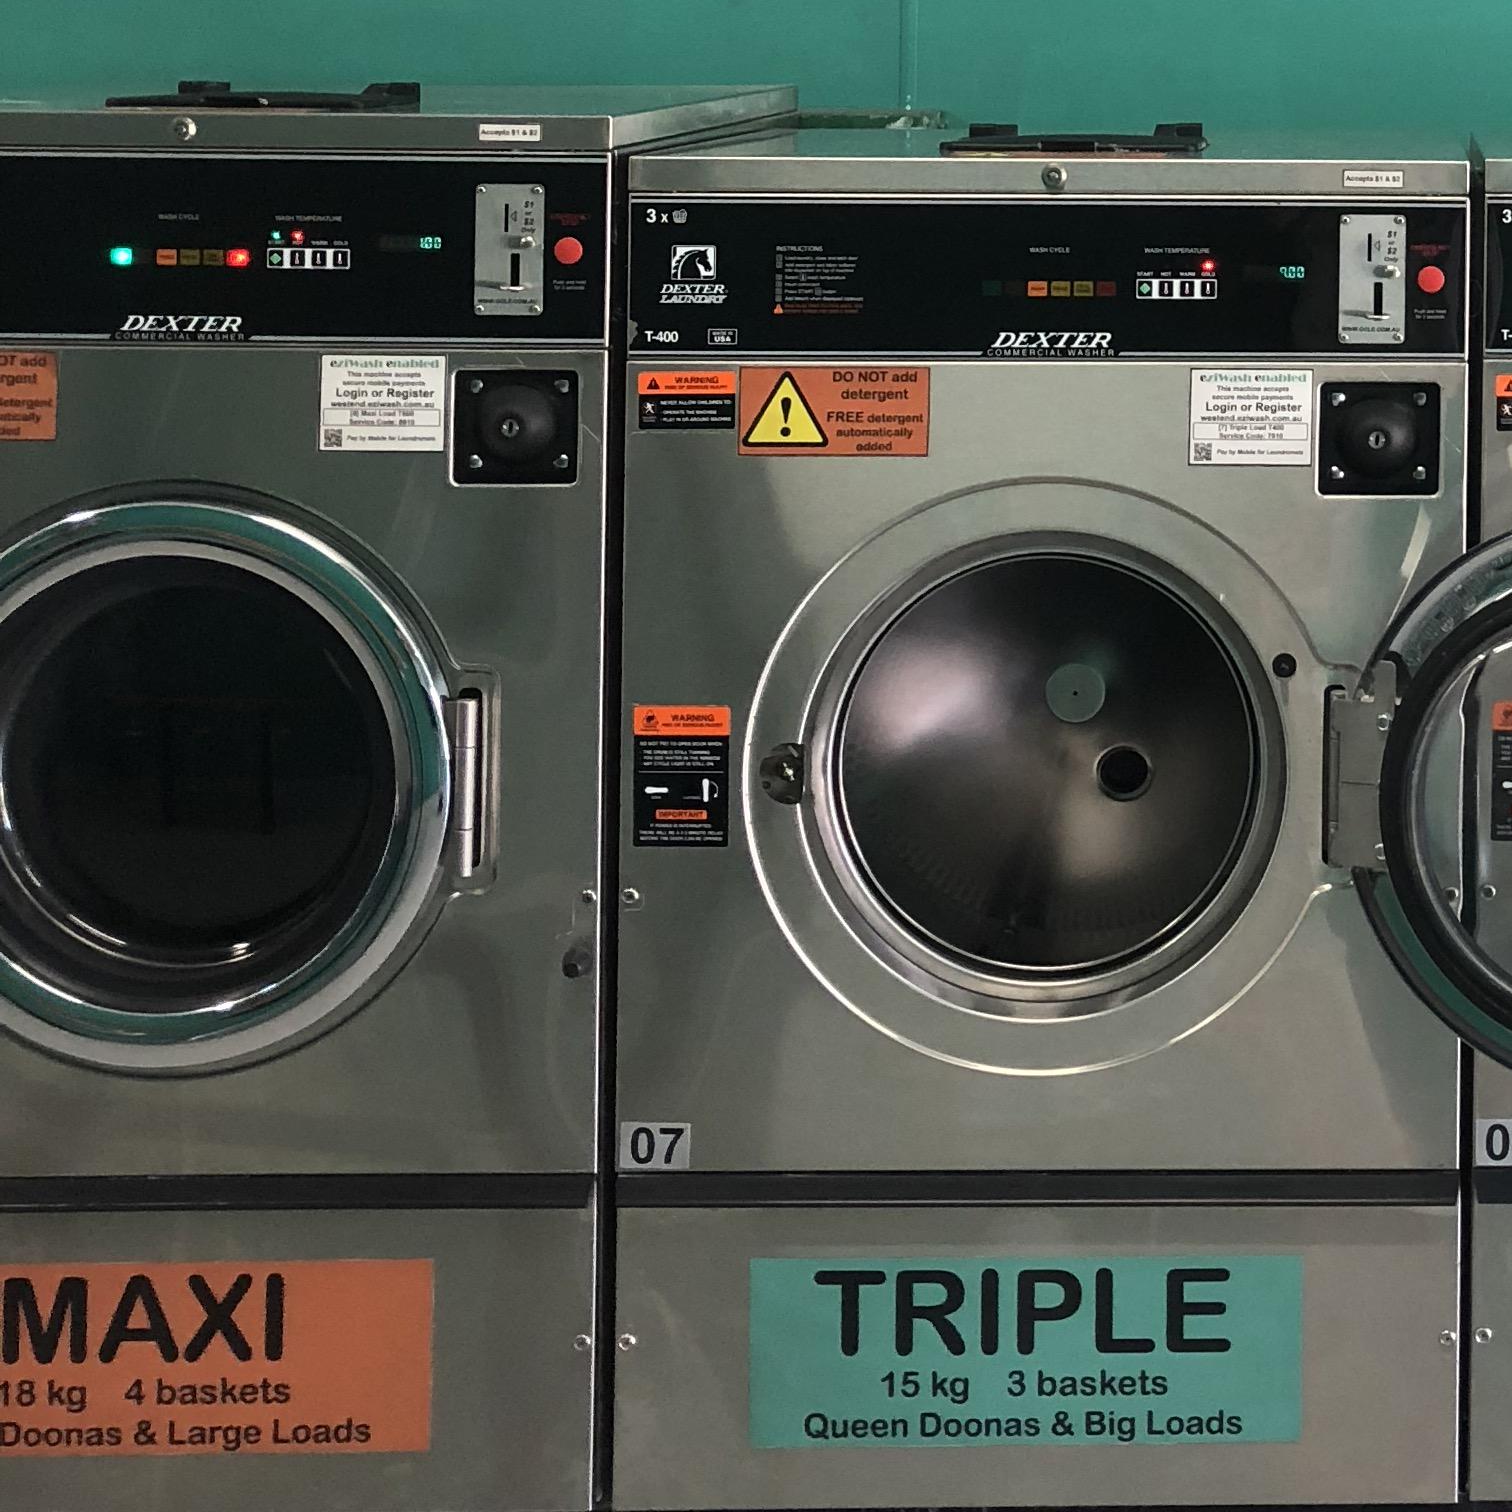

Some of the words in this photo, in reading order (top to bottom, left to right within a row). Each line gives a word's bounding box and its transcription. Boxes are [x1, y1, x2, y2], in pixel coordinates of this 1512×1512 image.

[646, 210, 656, 223] 3
[661, 213, 668, 223] x
[660, 284, 725, 294] DEXTER
[659, 295, 726, 304] LAUNDRY
[120, 316, 242, 332] DEXTER
[646, 331, 679, 342] T-400
[991, 332, 1112, 348] DEXTER
[833, 371, 854, 383] DO
[858, 371, 888, 383] NOT
[892, 371, 917, 383] add
[336, 388, 367, 400] Login
[387, 389, 435, 400] Register
[841, 387, 909, 402] detergent
[1206, 402, 1237, 413] Login
[1256, 402, 1302, 413] Register
[827, 411, 864, 423] FREE
[867, 412, 923, 425] detergent
[836, 426, 913, 440] automatically
[856, 441, 892, 451] added
[630, 1128, 684, 1166] 07
[1, 1273, 285, 1365] MAXI
[814, 1267, 1231, 1357] TRIPLE
[881, 1372, 920, 1399] 15
[931, 1370, 970, 1403] kg
[1007, 1370, 1026, 1397] 3
[1037, 1370, 1168, 1398] baskets
[48, 1380, 87, 1412] kg
[125, 1379, 145, 1404] 4
[157, 1377, 291, 1405] baskets
[804, 1412, 909, 1442] Queen
[920, 1412, 1040, 1438] Doonas
[1051, 1412, 1074, 1437] &
[1085, 1410, 1136, 1442] Big
[1148, 1409, 1242, 1436] Loads
[0, 1421, 122, 1448] Doonas
[134, 1420, 157, 1446] &
[169, 1420, 261, 1450] Large
[273, 1418, 371, 1446] Loads
